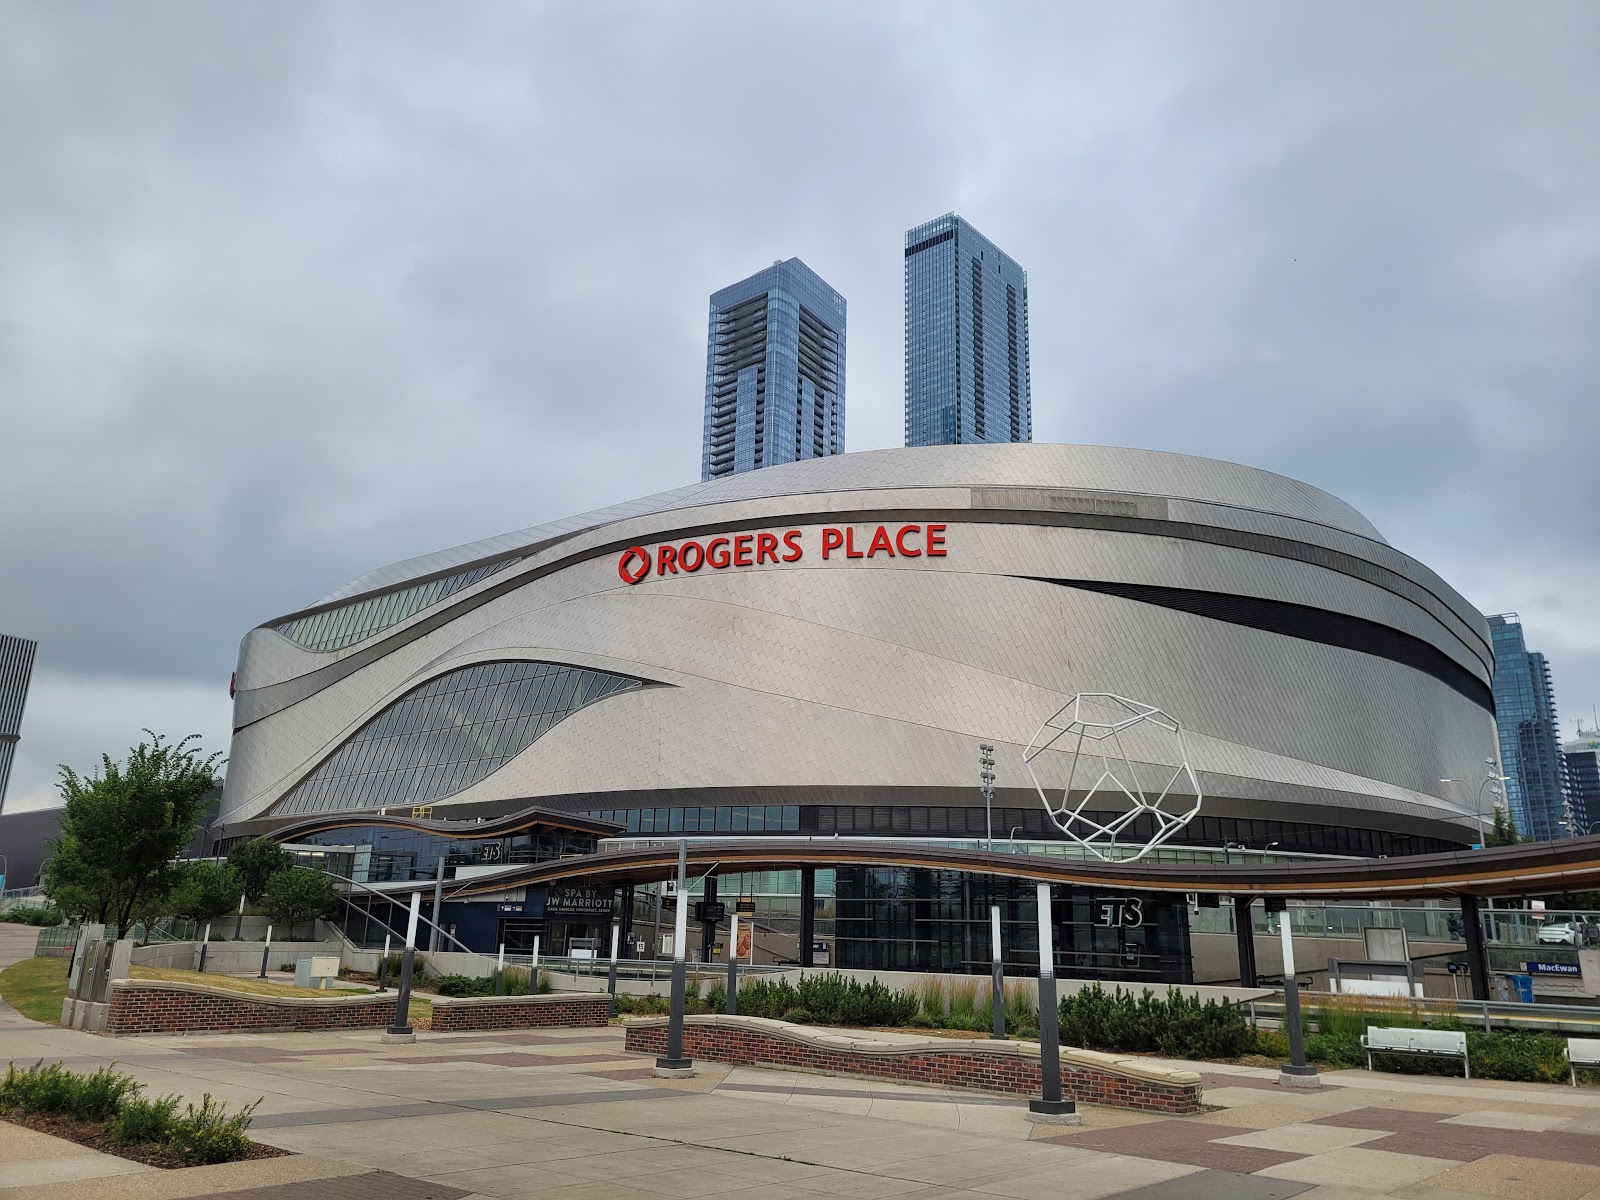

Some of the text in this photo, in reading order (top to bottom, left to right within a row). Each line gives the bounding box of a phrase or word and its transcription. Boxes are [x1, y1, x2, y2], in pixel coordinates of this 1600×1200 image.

[656, 524, 948, 576] ROGERS PLACE
[565, 889, 598, 898] SPA BY
[546, 896, 612, 907] JW MARRIOTT
[1094, 898, 1142, 927] ETS
[1538, 964, 1577, 972] MacEwan
